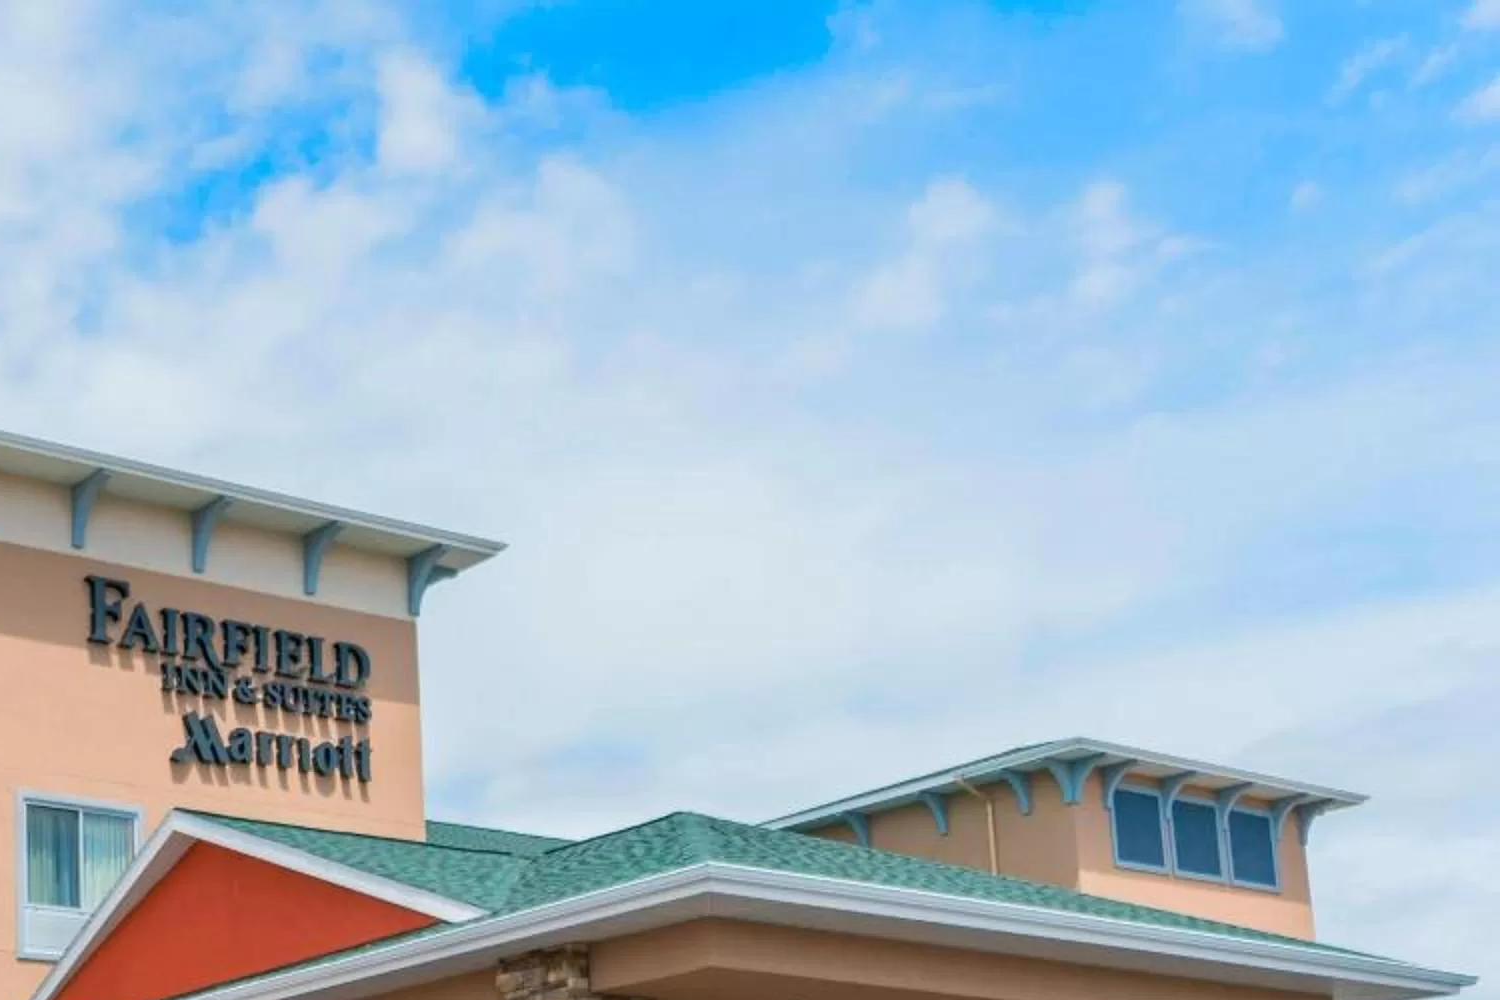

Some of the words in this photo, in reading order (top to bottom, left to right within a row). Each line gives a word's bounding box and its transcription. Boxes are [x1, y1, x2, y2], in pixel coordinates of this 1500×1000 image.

[84, 574, 372, 689] FAIRFIELD
[161, 662, 229, 700] INN
[232, 676, 258, 705] &
[262, 682, 372, 724] SUITES
[170, 710, 372, 783] Marriott
